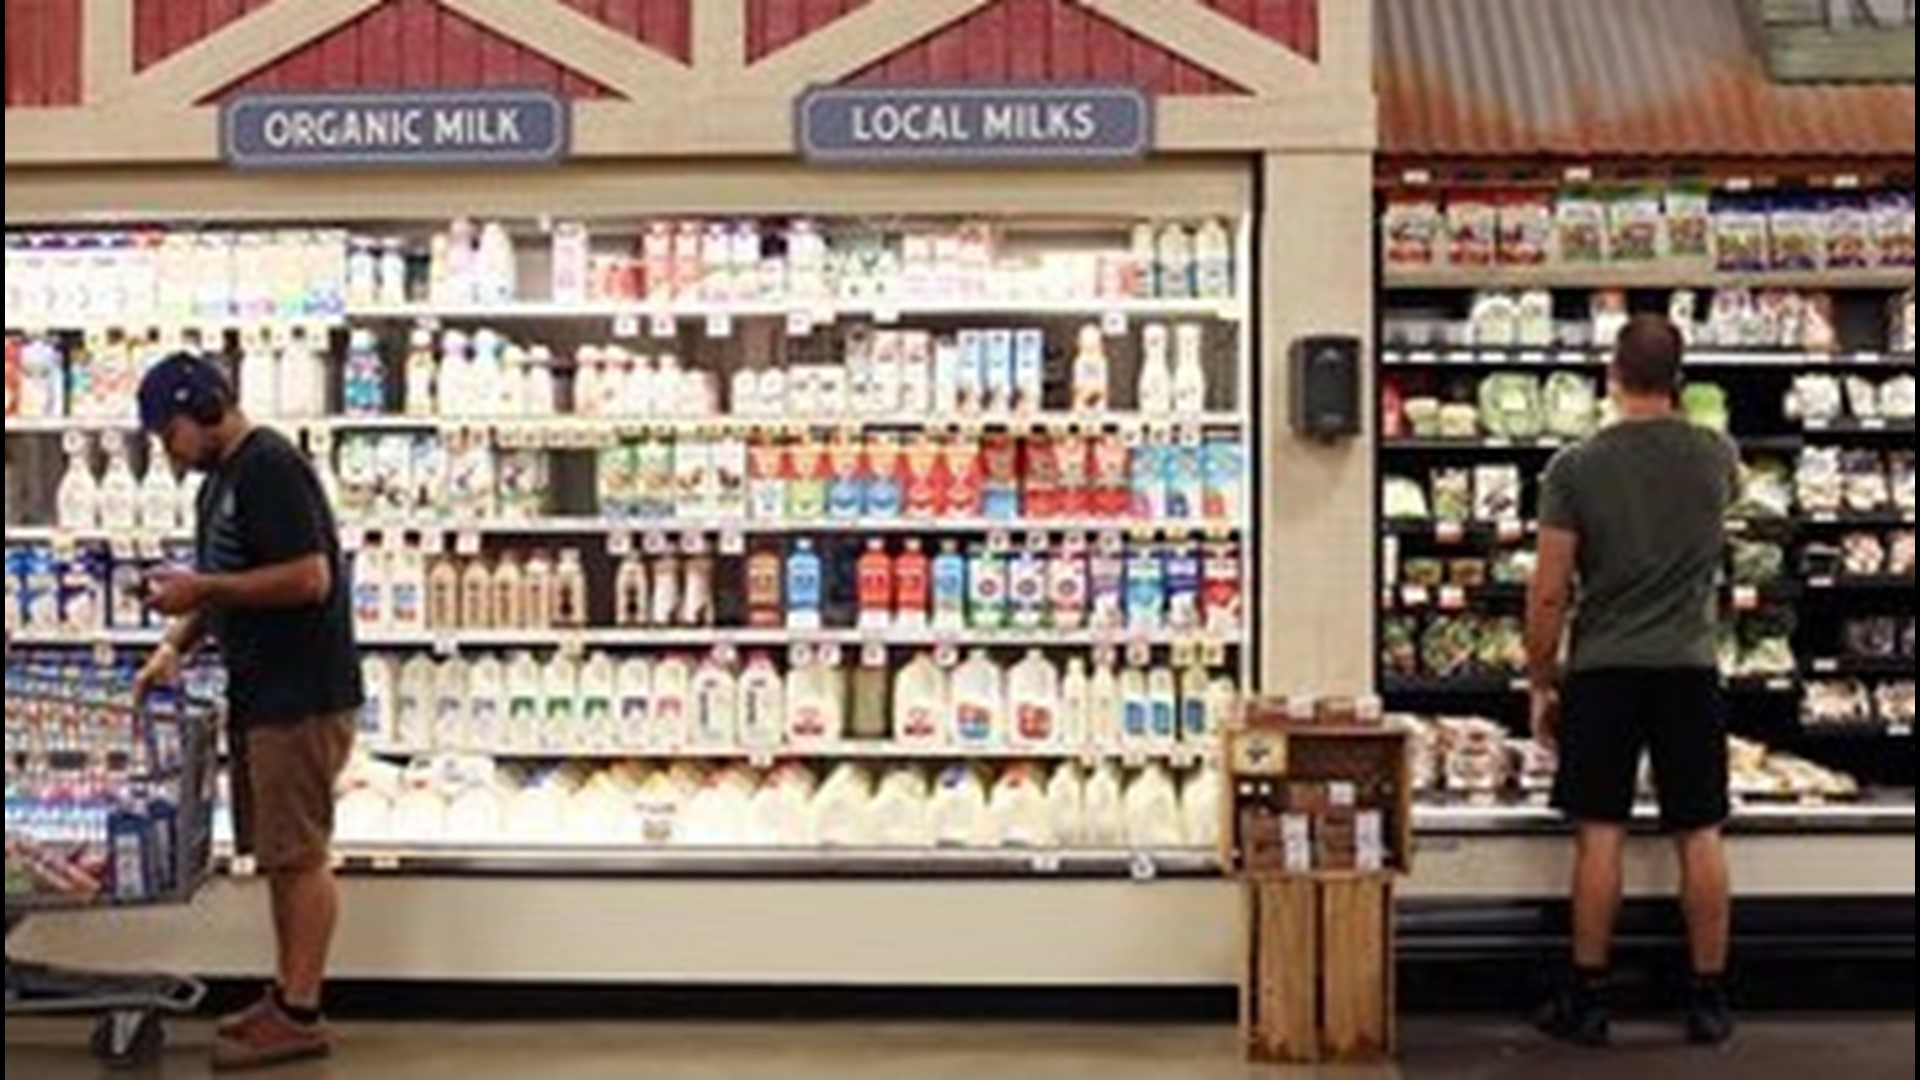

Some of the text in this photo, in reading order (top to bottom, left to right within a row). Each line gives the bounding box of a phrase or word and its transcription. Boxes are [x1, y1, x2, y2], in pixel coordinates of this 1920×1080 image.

[263, 108, 521, 147] ORGANIC MILK
[852, 103, 1096, 140] LOCAL MILKS
